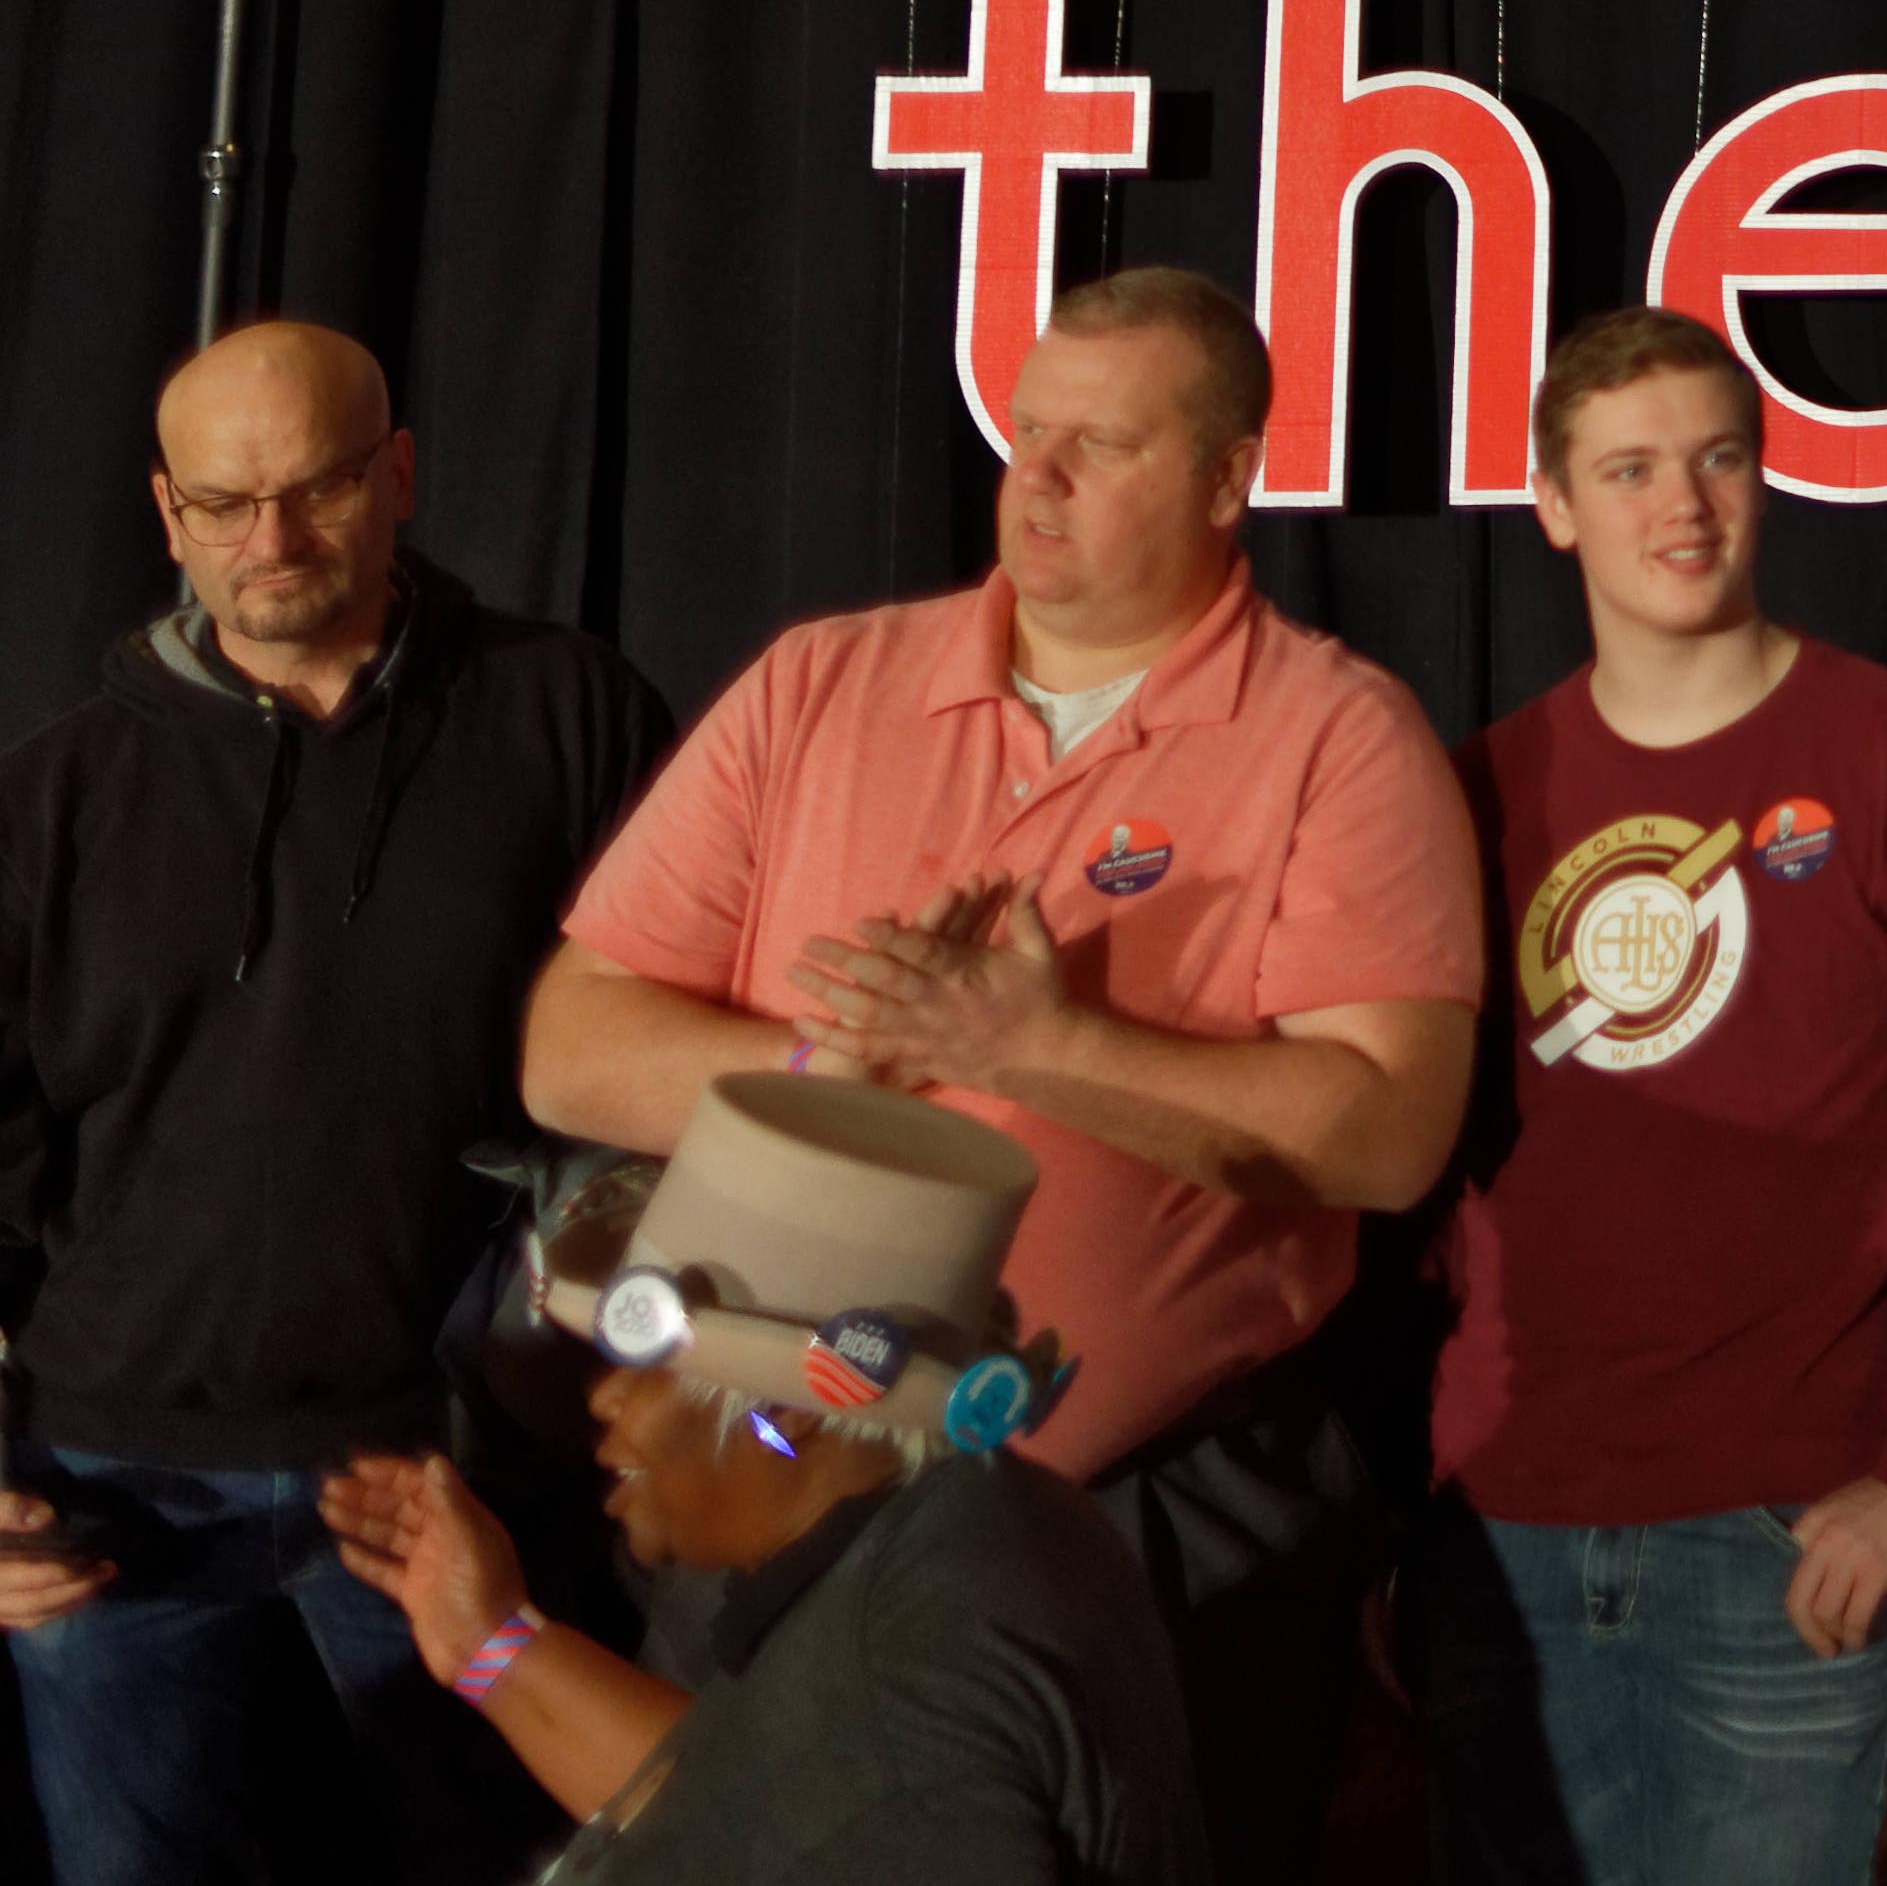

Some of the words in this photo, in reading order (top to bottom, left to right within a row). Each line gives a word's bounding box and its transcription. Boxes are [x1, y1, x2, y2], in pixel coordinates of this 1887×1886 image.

[1529, 822, 1656, 935] LINCOLN
[1609, 950, 1737, 1064] WRESTLING
[833, 1327, 891, 1365] BIDEN
